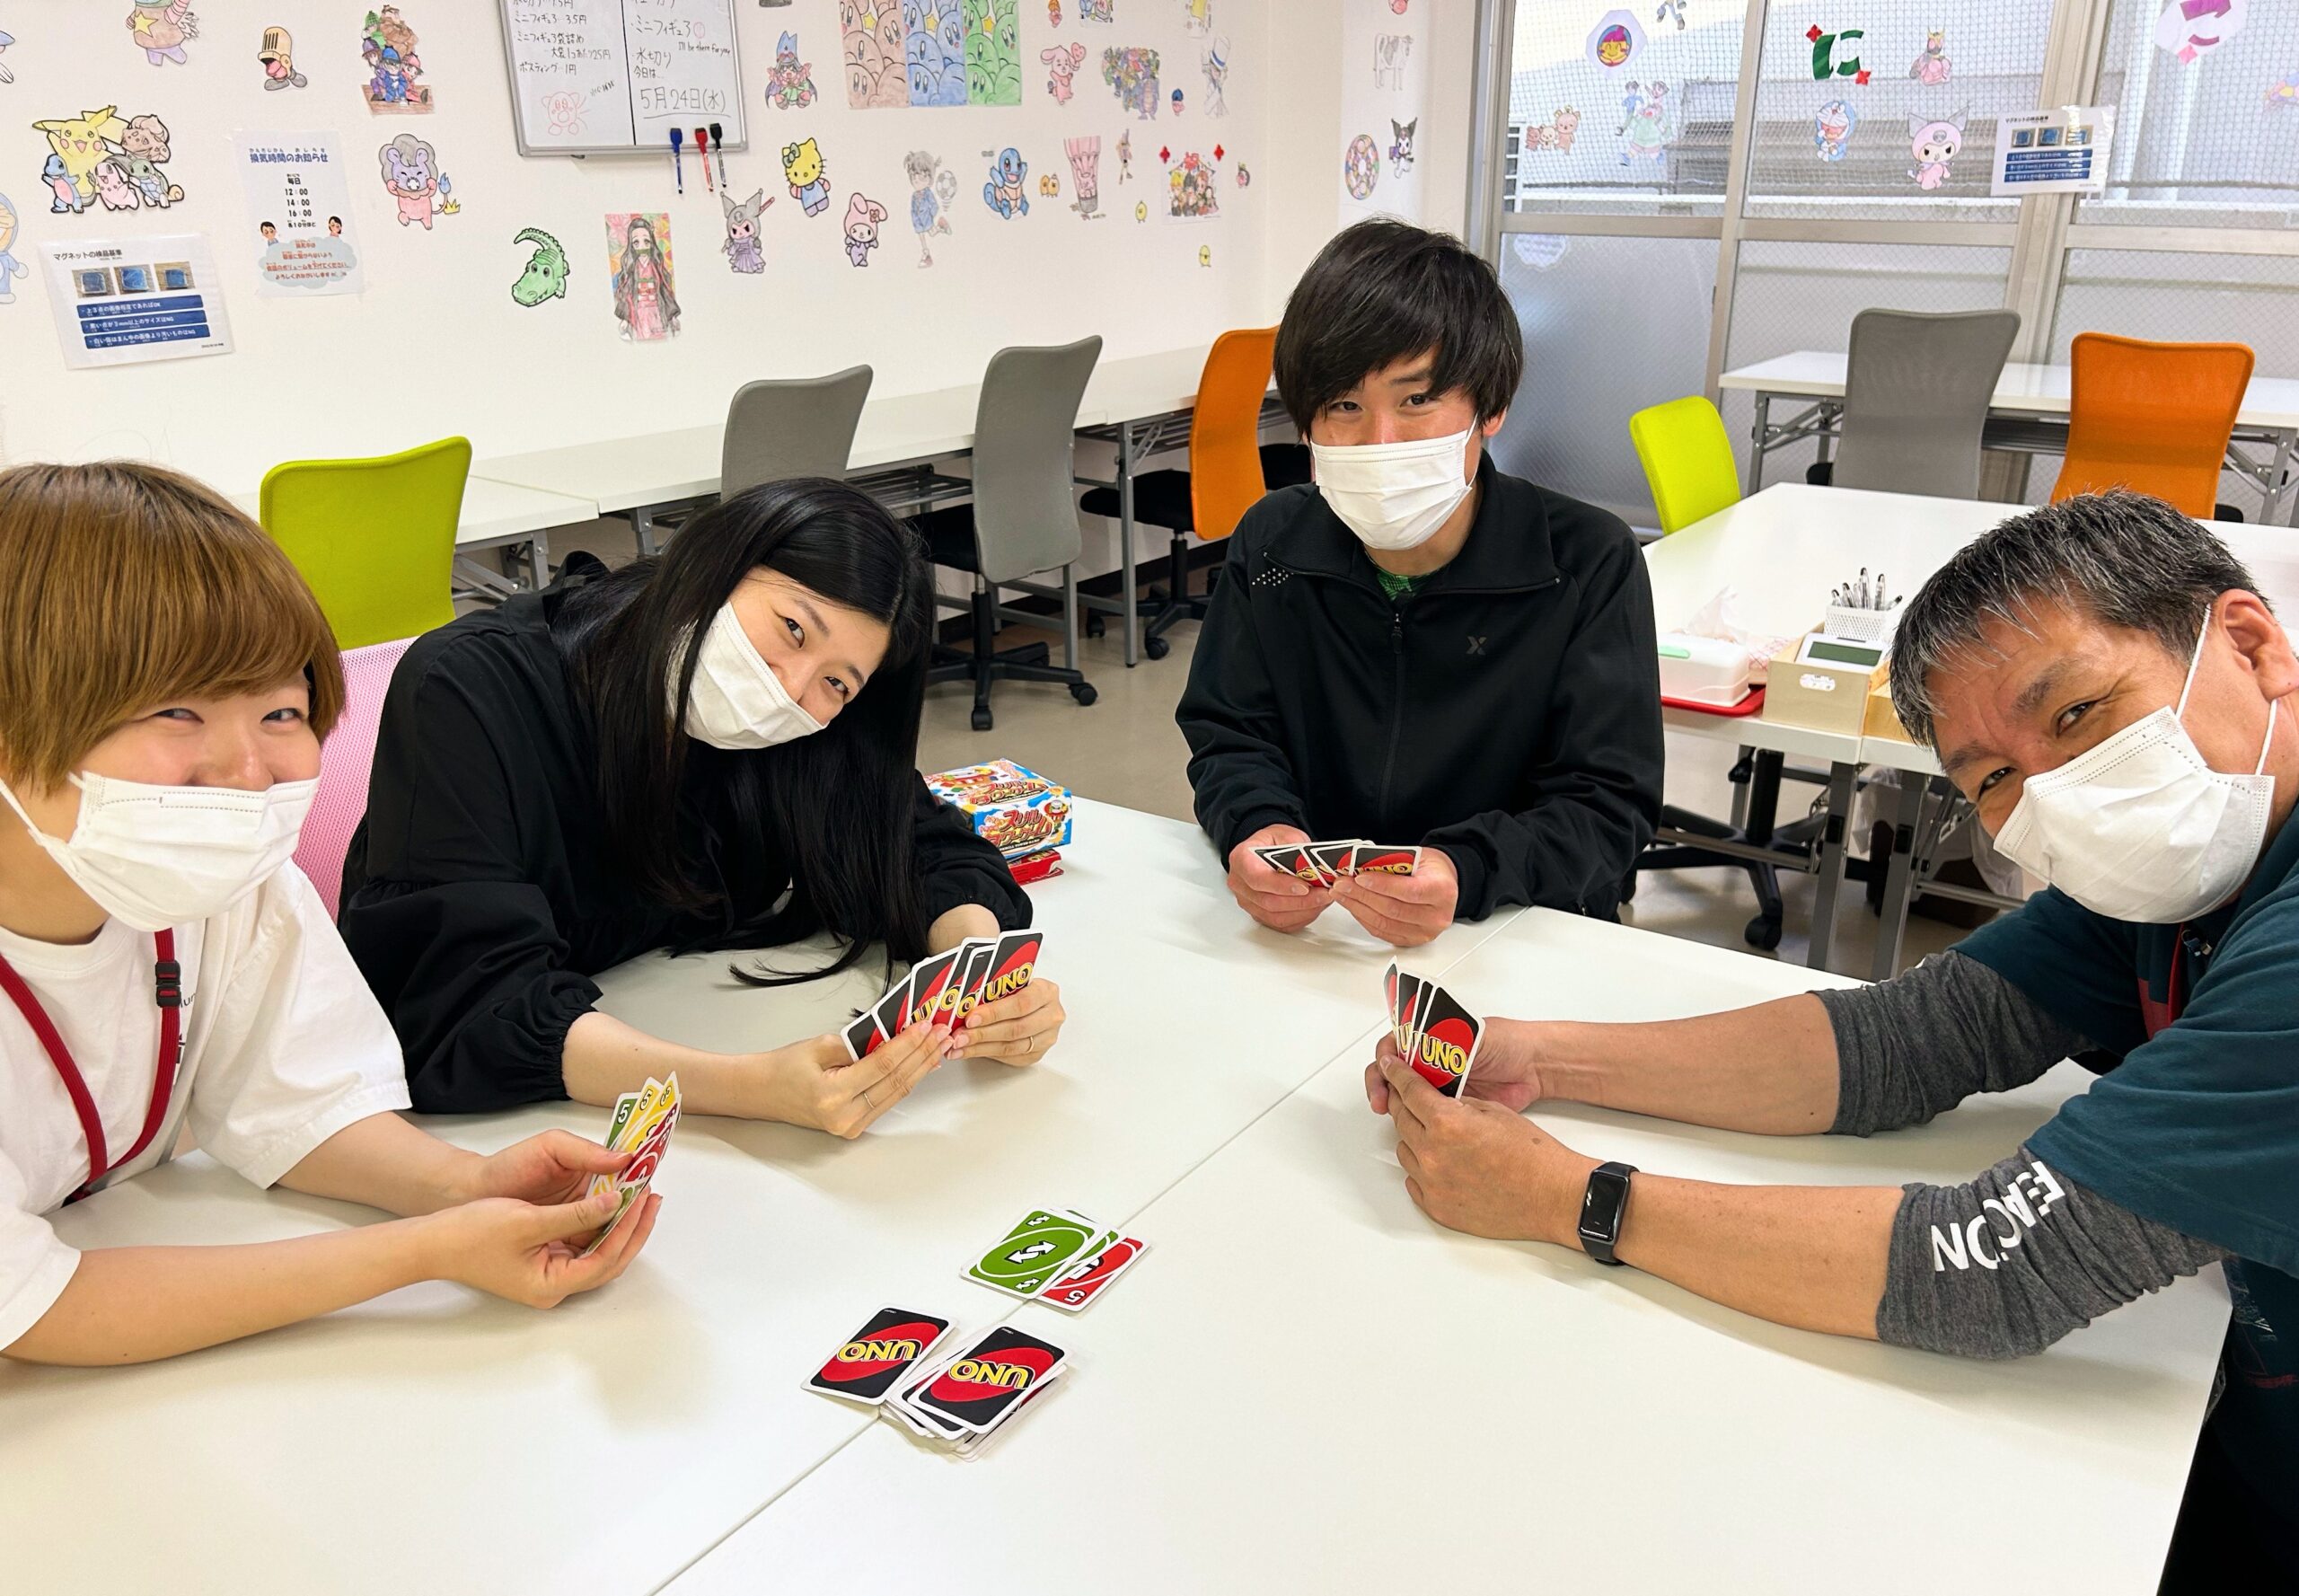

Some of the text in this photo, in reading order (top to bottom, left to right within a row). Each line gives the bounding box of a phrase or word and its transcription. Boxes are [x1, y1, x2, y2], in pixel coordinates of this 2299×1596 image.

[688, 41, 695, 51] be
[1812, 30, 1864, 80] に
[250, 153, 329, 163] 換気時間のお知らせ
[287, 177, 301, 185] 毎日
[983, 962, 1034, 1004] UNO
[1420, 1033, 1467, 1076] UNO
[640, 1089, 653, 1110] 5
[617, 1103, 630, 1124] 5
[837, 1339, 922, 1362] UNO
[948, 1359, 1036, 1389] UNO
